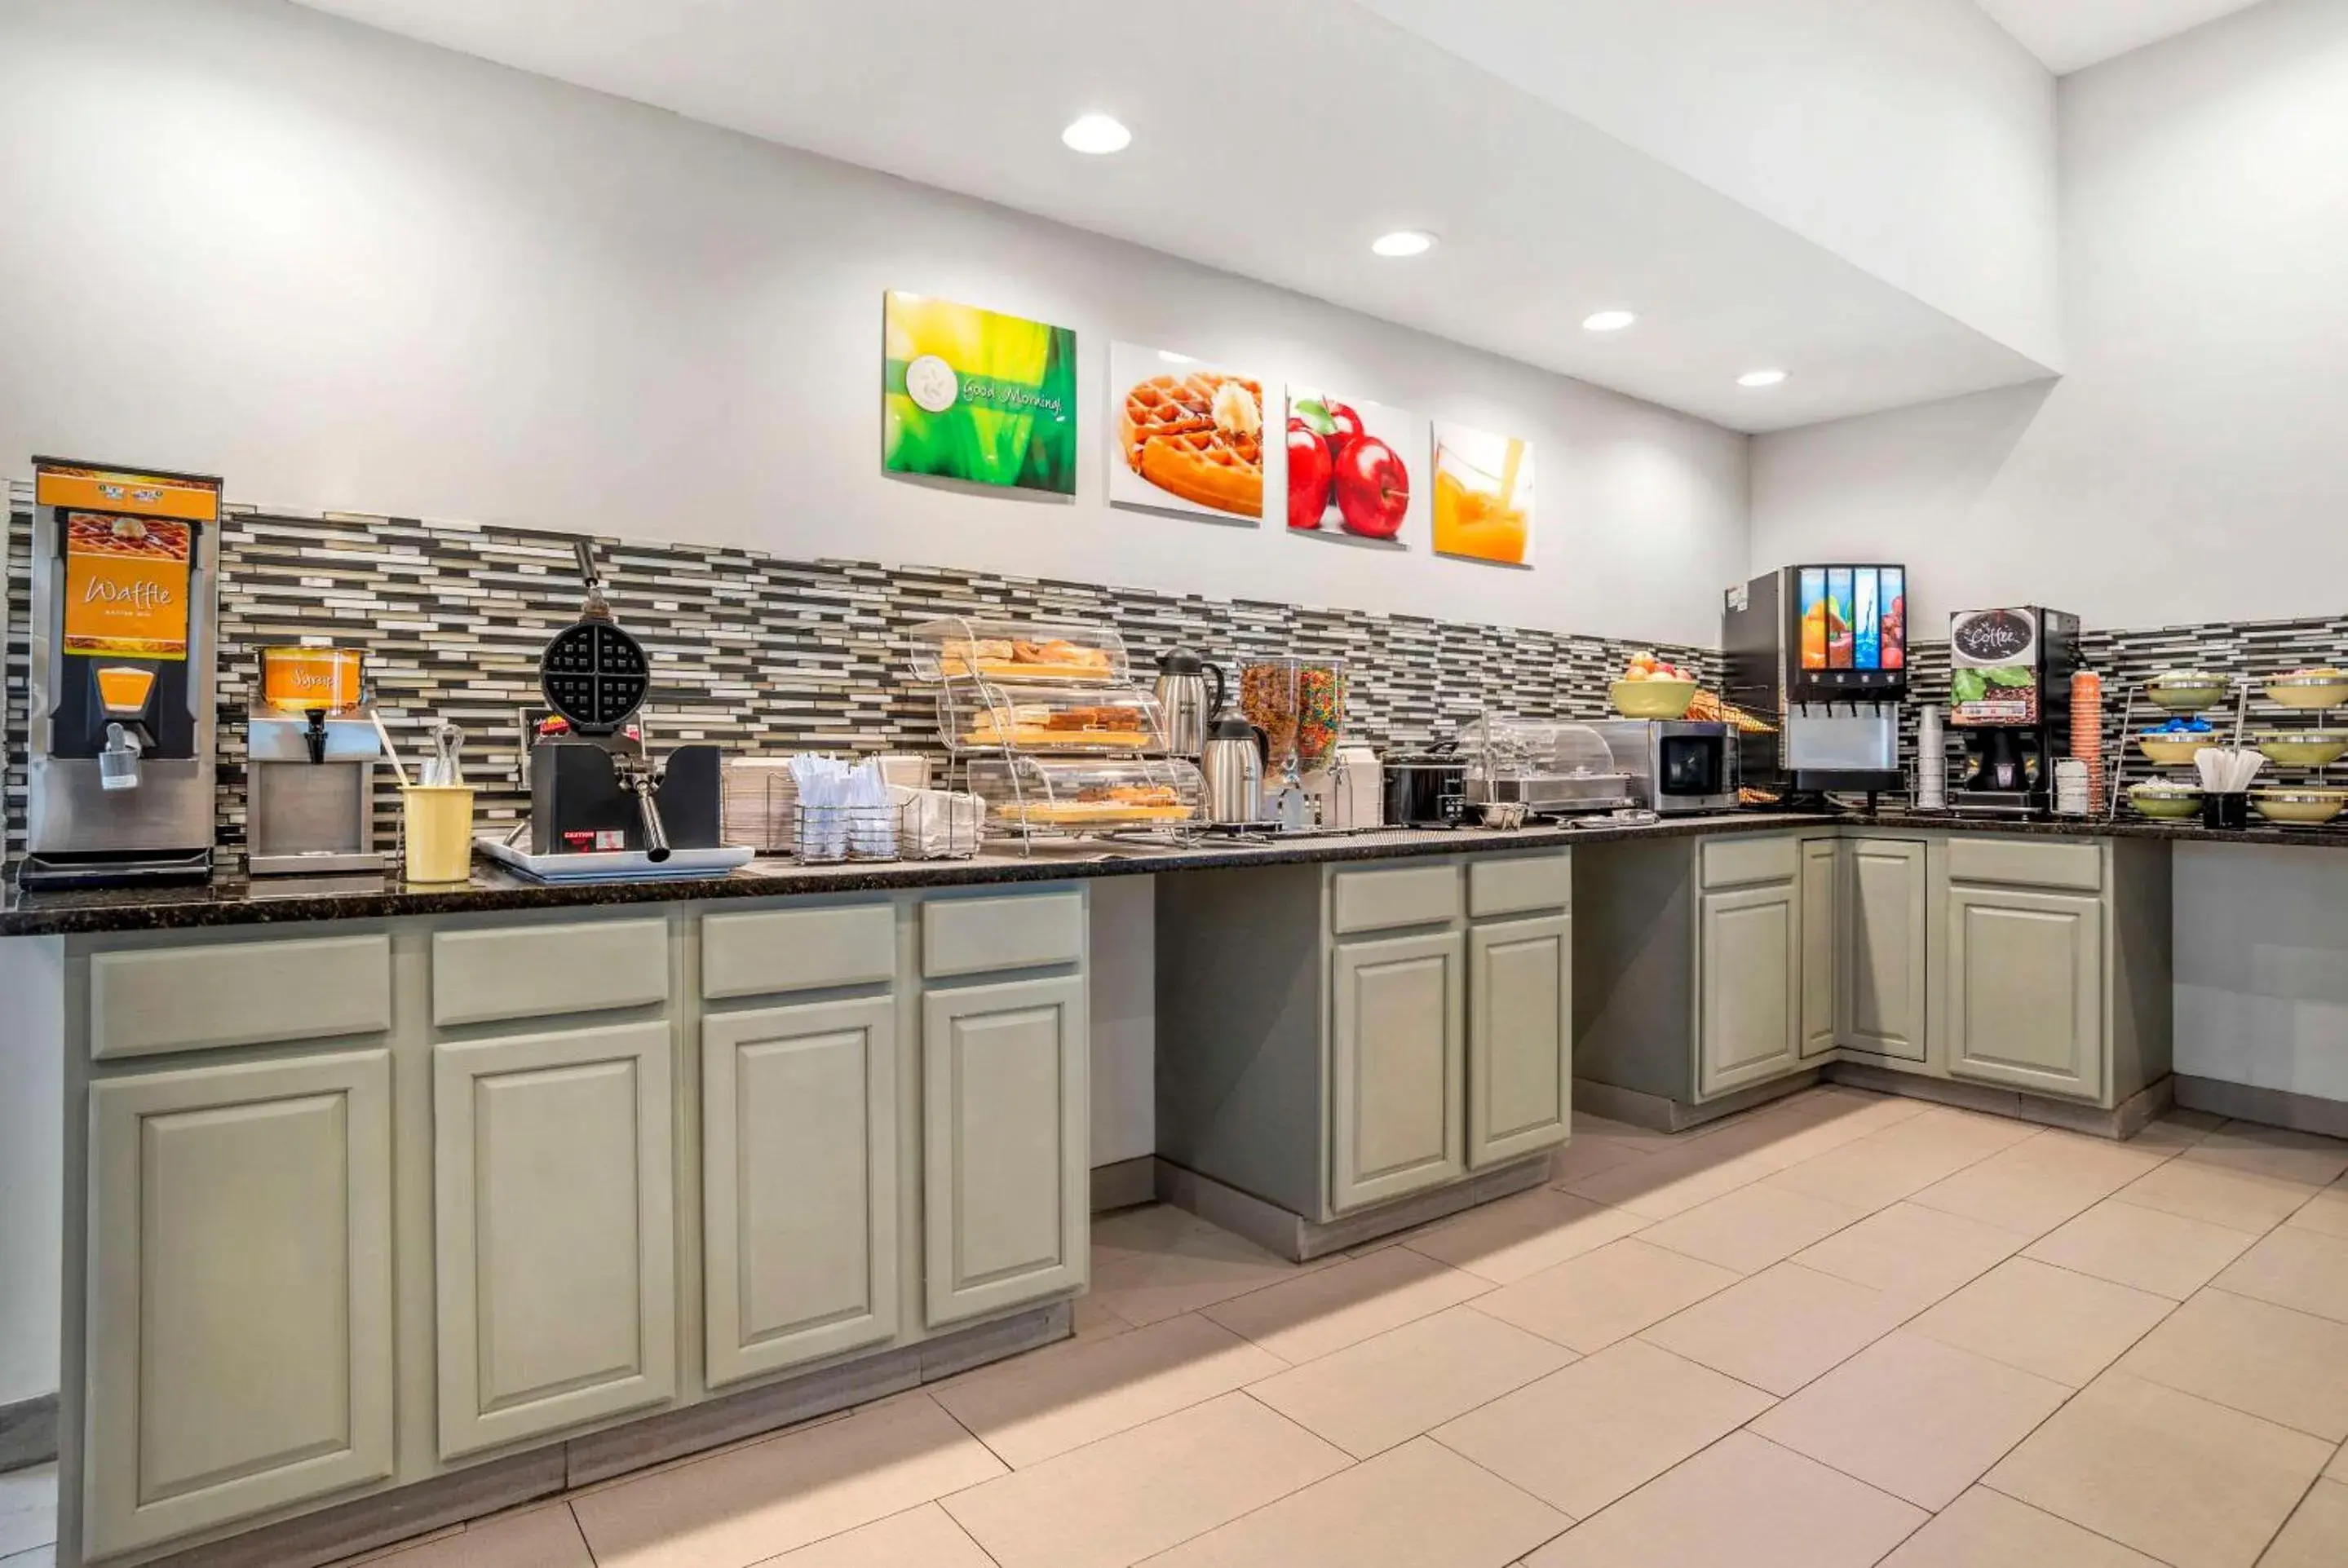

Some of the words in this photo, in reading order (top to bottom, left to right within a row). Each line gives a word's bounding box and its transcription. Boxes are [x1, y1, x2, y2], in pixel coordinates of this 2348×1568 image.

[963, 378, 995, 402] Good
[84, 574, 171, 610] Waffle
[1971, 625, 2014, 647] Coffee
